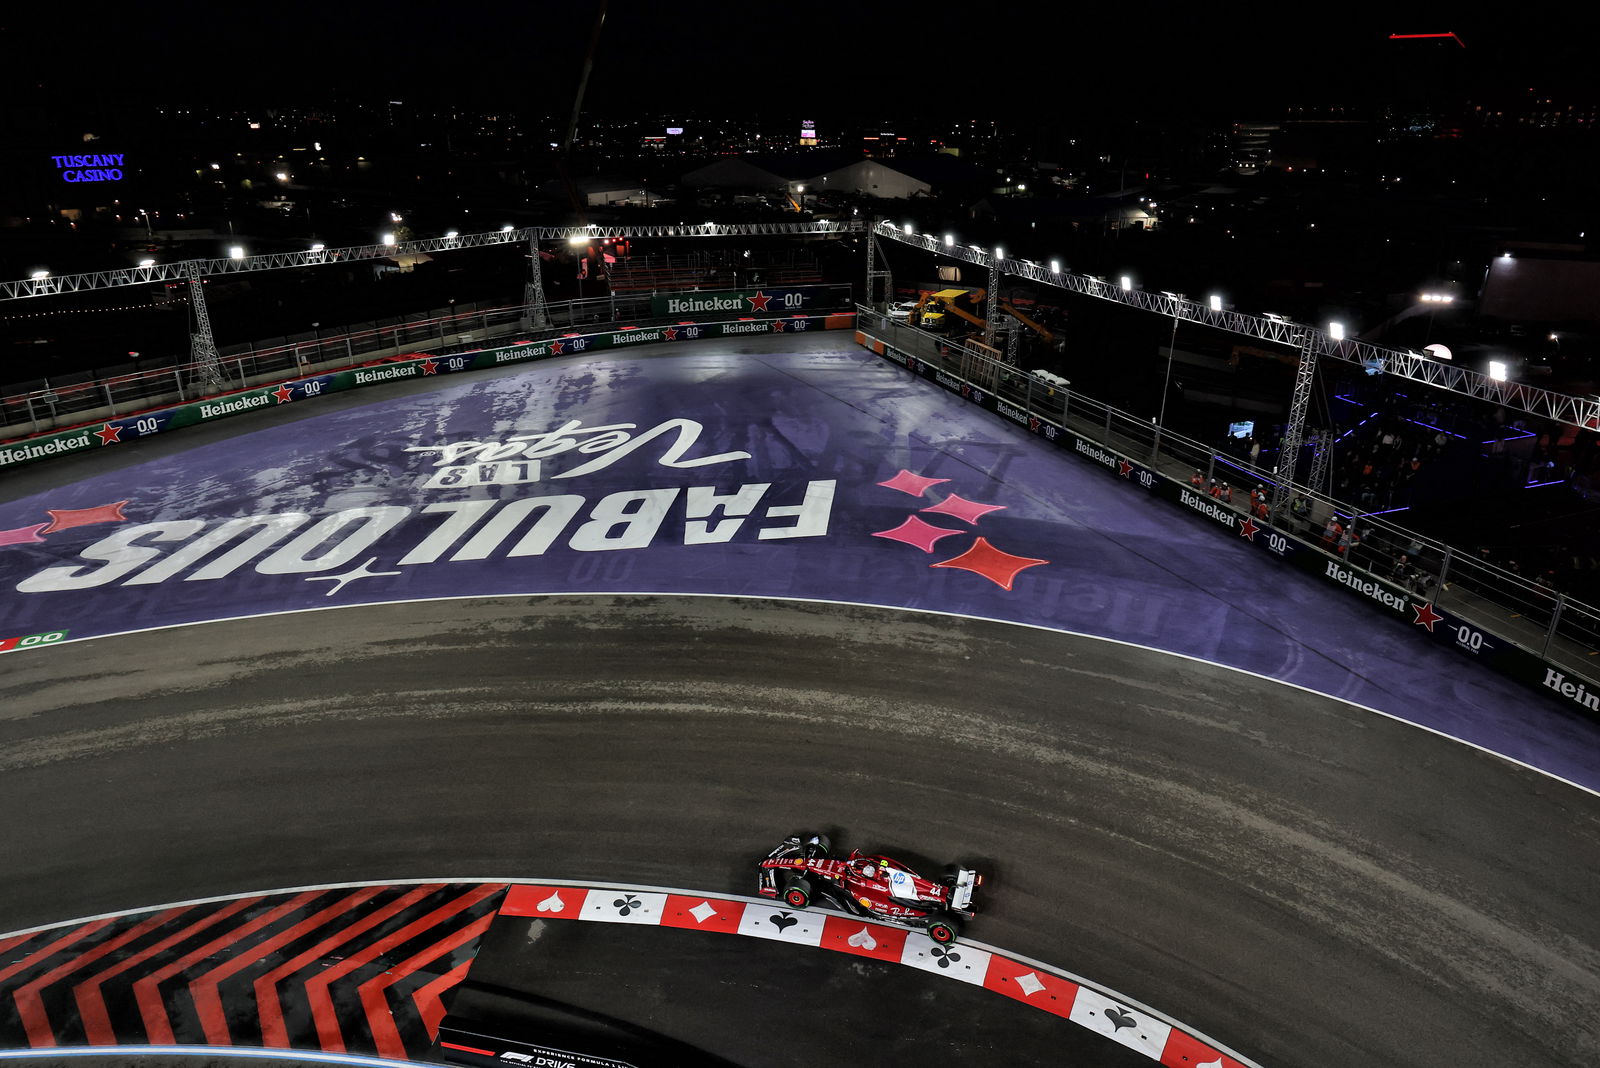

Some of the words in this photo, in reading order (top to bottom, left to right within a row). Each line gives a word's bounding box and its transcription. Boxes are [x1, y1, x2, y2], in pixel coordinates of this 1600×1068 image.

[51, 154, 124, 168] TUSCANY
[63, 168, 123, 182] CASINO
[668, 297, 742, 313] Heineken
[612, 331, 660, 345] Heineken
[722, 323, 768, 334] Heineken
[495, 346, 546, 362] Heineken
[355, 366, 416, 384] Heineken
[200, 394, 270, 419] Heineken
[997, 401, 1028, 425] Heineken
[0, 435, 91, 465] Heineken
[405, 418, 752, 479] Vegas
[1076, 439, 1116, 468] Heineken
[436, 462, 532, 486] LAS
[1180, 489, 1235, 528] Heineken
[16, 479, 837, 593] FABULOUS
[1325, 560, 1405, 612] Heineken
[1542, 667, 1600, 712] Hein
[929, 887, 941, 897] 44
[533, 1049, 576, 1060] EXPERIENCE
[577, 1056, 610, 1067] FORMULA
